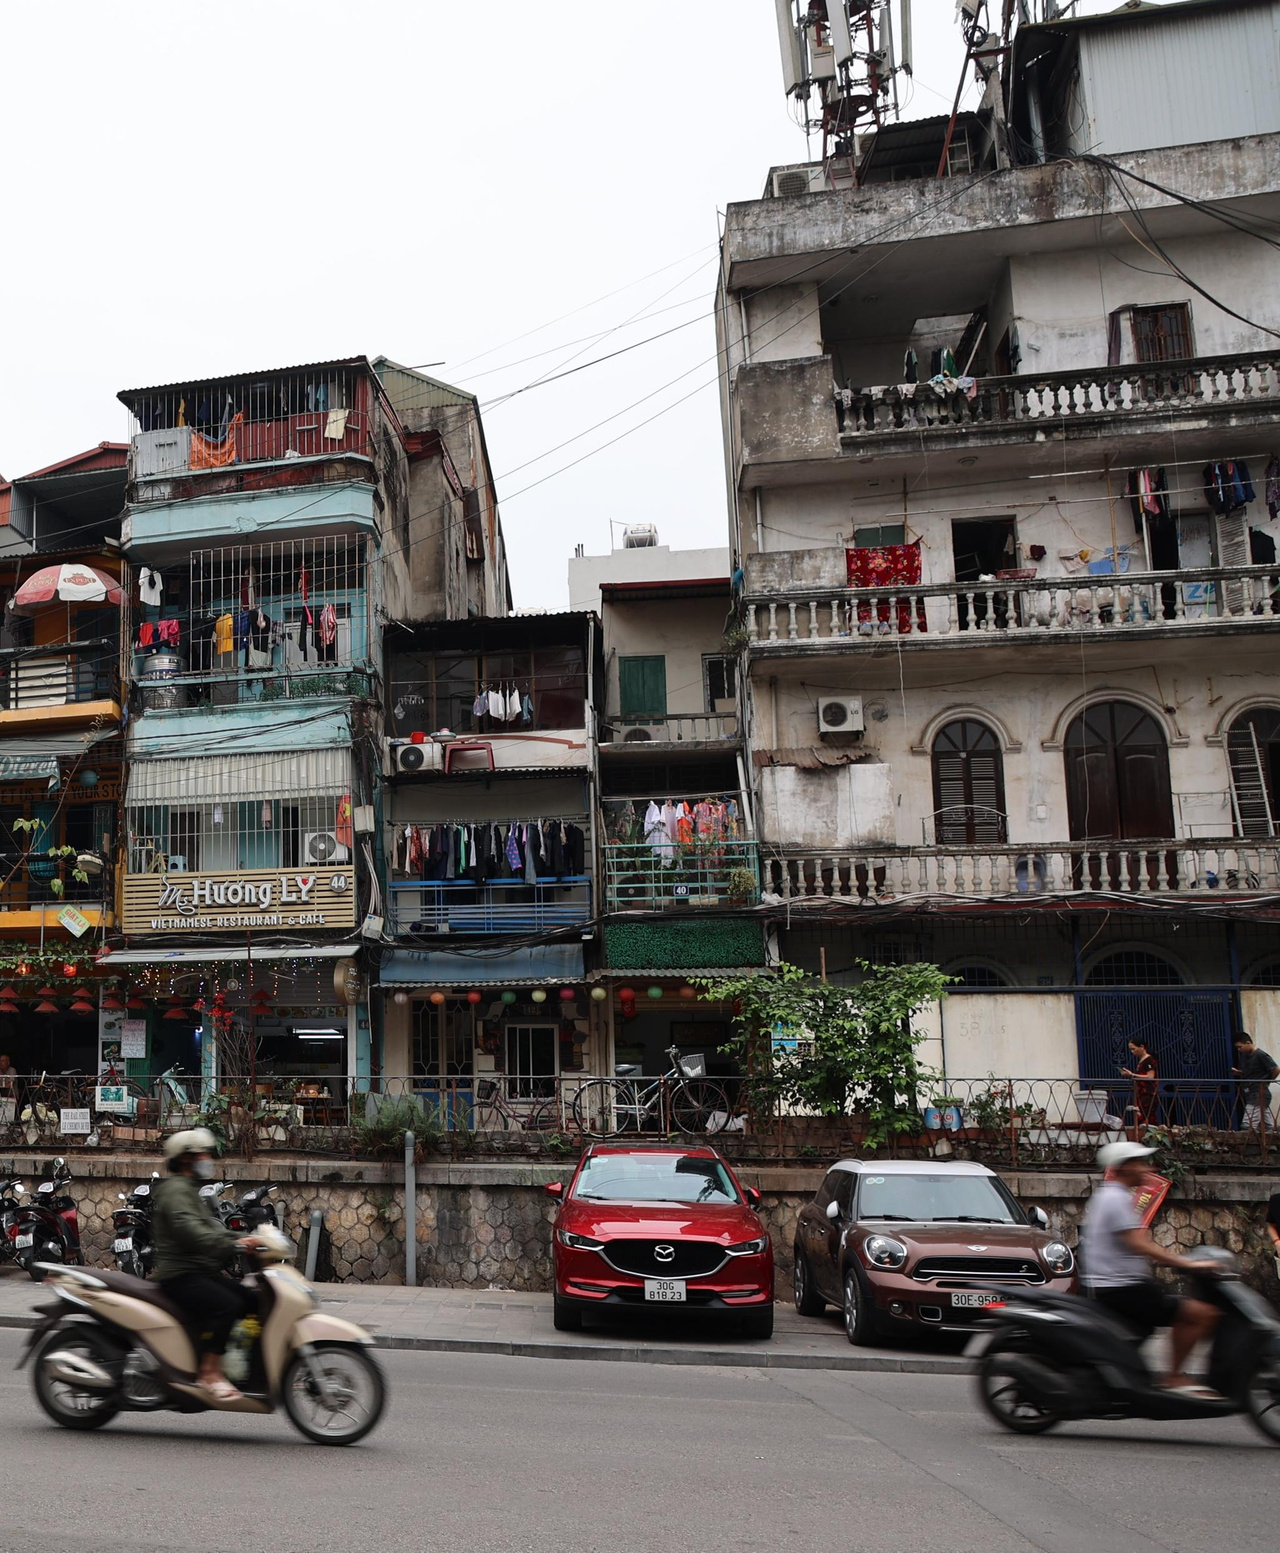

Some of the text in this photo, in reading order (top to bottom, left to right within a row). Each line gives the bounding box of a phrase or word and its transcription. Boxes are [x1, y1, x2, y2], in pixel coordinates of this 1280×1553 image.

[72, 784, 100, 799] YOUR
[280, 876, 316, 902] LY
[331, 876, 346, 889] 44
[676, 886, 687, 895] 40
[151, 913, 325, 929] VIETNAMESE RESTAURANT & CAFE
[656, 1281, 674, 1291] 30G
[649, 1291, 682, 1300] 818.23
